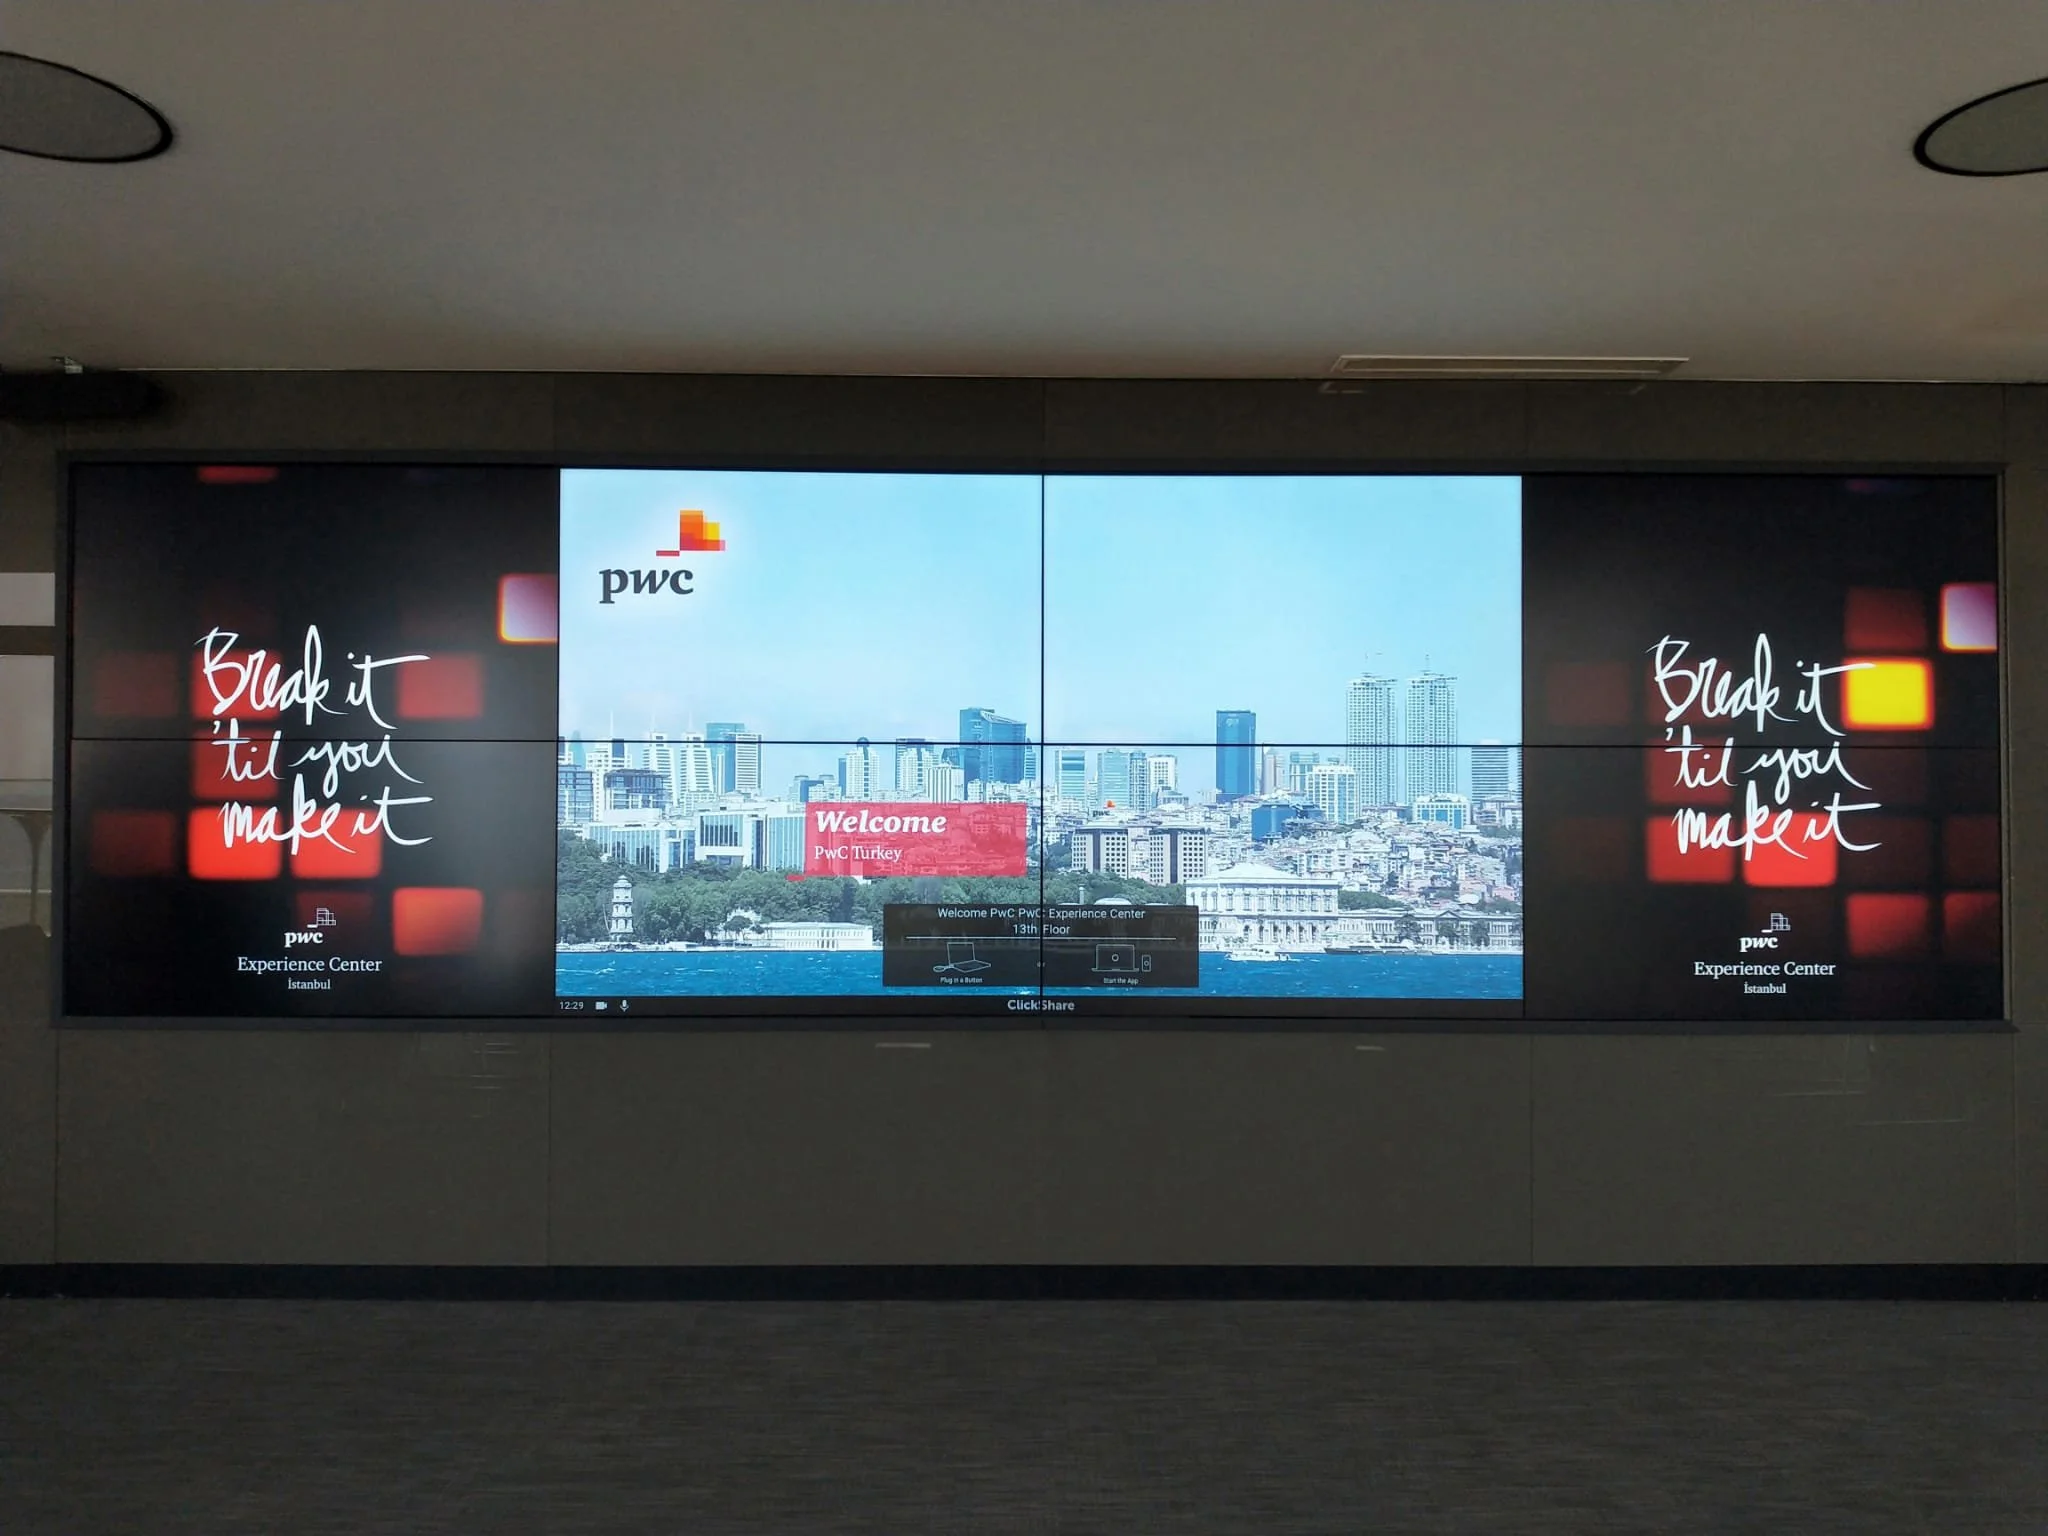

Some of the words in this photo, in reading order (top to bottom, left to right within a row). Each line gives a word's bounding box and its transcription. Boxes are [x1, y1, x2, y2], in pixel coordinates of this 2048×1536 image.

[599, 568, 694, 604] pwc
[194, 624, 349, 726] Break
[345, 652, 431, 730] it
[1646, 633, 1799, 733] Break
[1795, 660, 1877, 737] it
[288, 734, 425, 799] you
[1740, 741, 1873, 805] you
[217, 773, 357, 856] make
[351, 786, 433, 846] it
[815, 809, 947, 834] Welcome
[1671, 780, 1809, 862] make
[1803, 792, 1882, 851] it
[814, 845, 848, 860] PwC
[852, 845, 902, 863] Turkey
[937, 907, 987, 918] Welcome
[990, 907, 1015, 918] PwC
[1048, 908, 1107, 920] Experience
[1110, 908, 1146, 919] Center
[284, 931, 324, 948] pwc
[1013, 924, 1037, 934] 13th
[1042, 924, 1071, 934] Floor
[1739, 937, 1778, 952] pwc
[237, 956, 325, 975] Experience
[329, 956, 383, 972] Center
[1693, 961, 1781, 980] Experience
[1783, 961, 1836, 976] Center
[560, 1001, 584, 1010] 12:29
